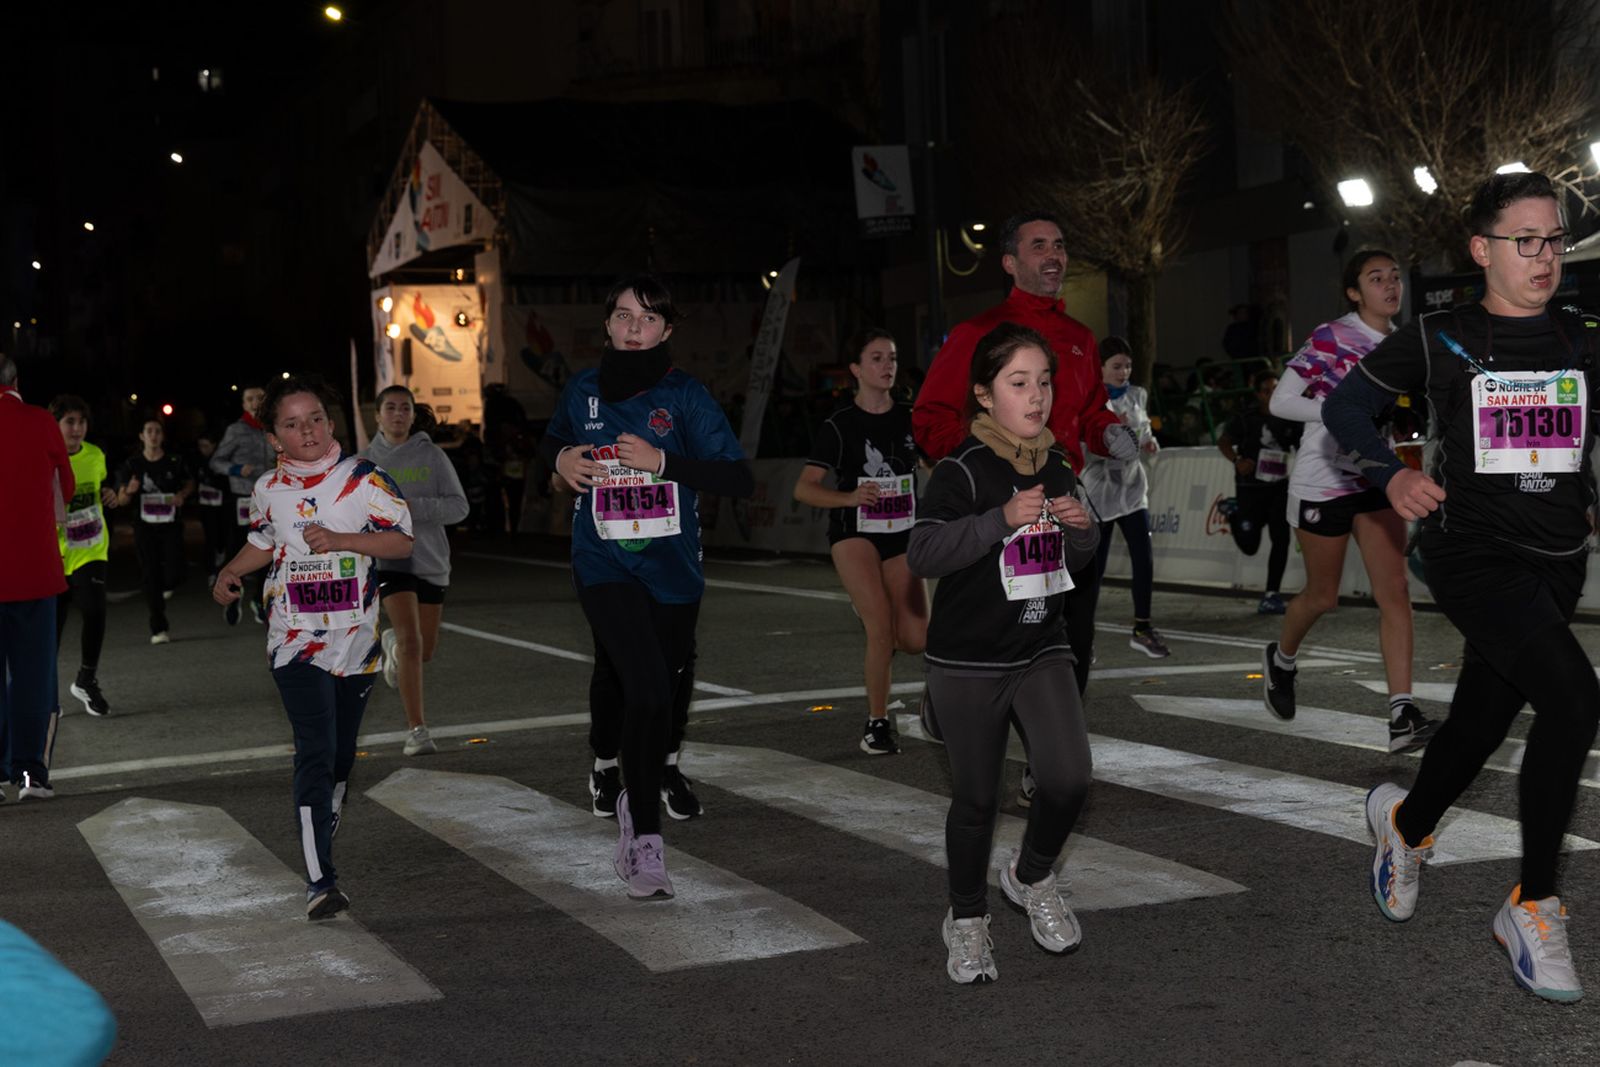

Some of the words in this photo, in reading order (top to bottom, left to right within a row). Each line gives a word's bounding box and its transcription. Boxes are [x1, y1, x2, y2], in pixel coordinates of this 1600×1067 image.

[1487, 395, 1509, 406] SAN
[1511, 392, 1547, 405] ANTÓN
[1490, 408, 1573, 437] 15130
[610, 468, 632, 476] NOCHE
[1520, 472, 1543, 480] SAN
[1519, 477, 1556, 489] ANTÓN
[602, 485, 669, 512] 15654
[298, 563, 321, 572] NOCHE
[290, 574, 305, 582] SAN
[295, 580, 352, 606] 15467
[1026, 601, 1045, 610] SAN
